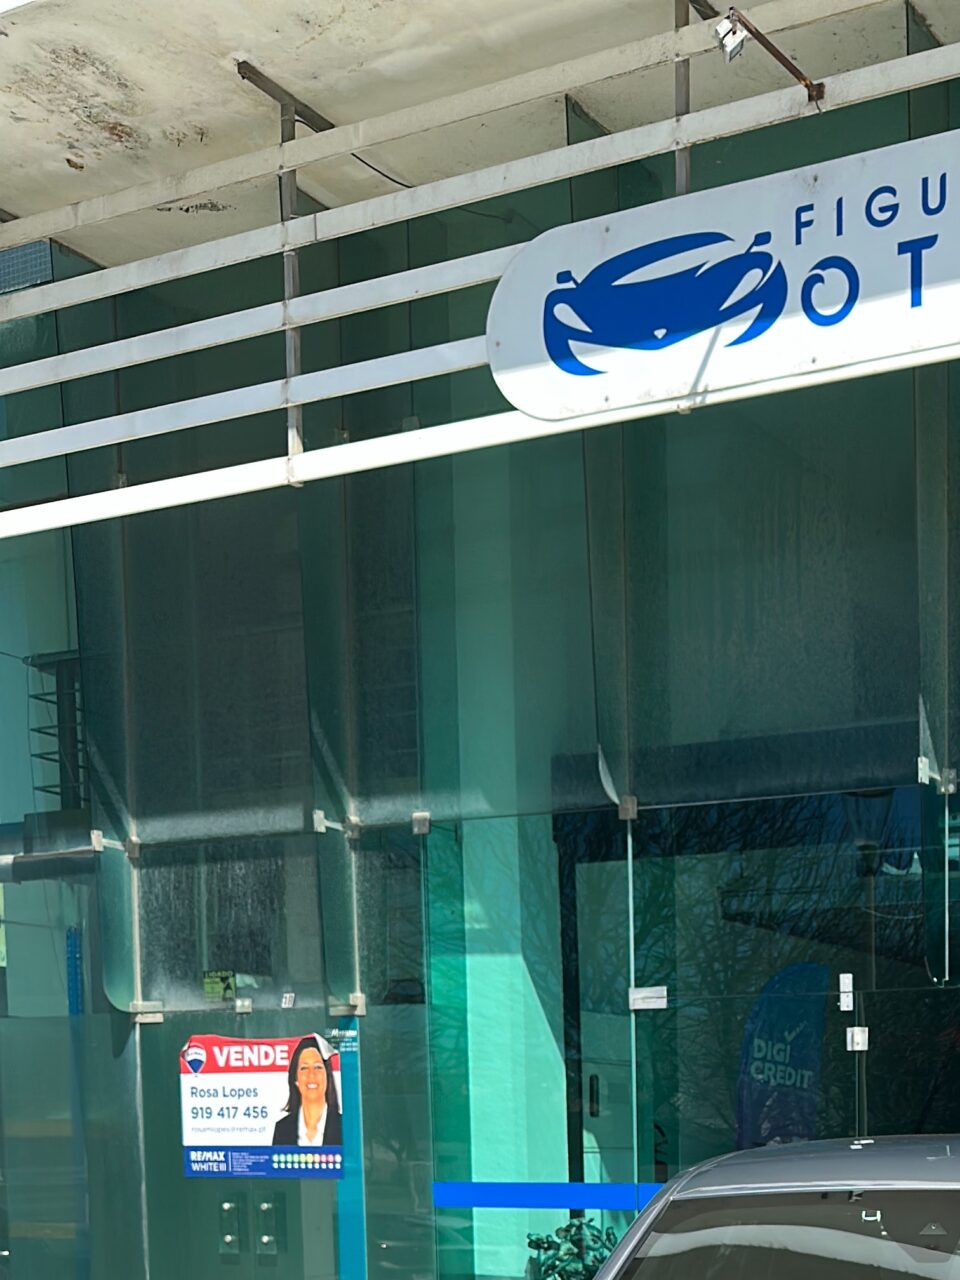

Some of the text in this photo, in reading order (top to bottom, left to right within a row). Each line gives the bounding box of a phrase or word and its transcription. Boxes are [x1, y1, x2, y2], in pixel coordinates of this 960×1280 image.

[212, 1045, 289, 1067] VENDE
[753, 1038, 791, 1063] DIGI
[750, 1060, 813, 1089] CREDIT
[190, 1085, 258, 1100] Rosa Lopes
[191, 1106, 268, 1119] 919 417 456
[190, 1151, 225, 1161] RE/MAX
